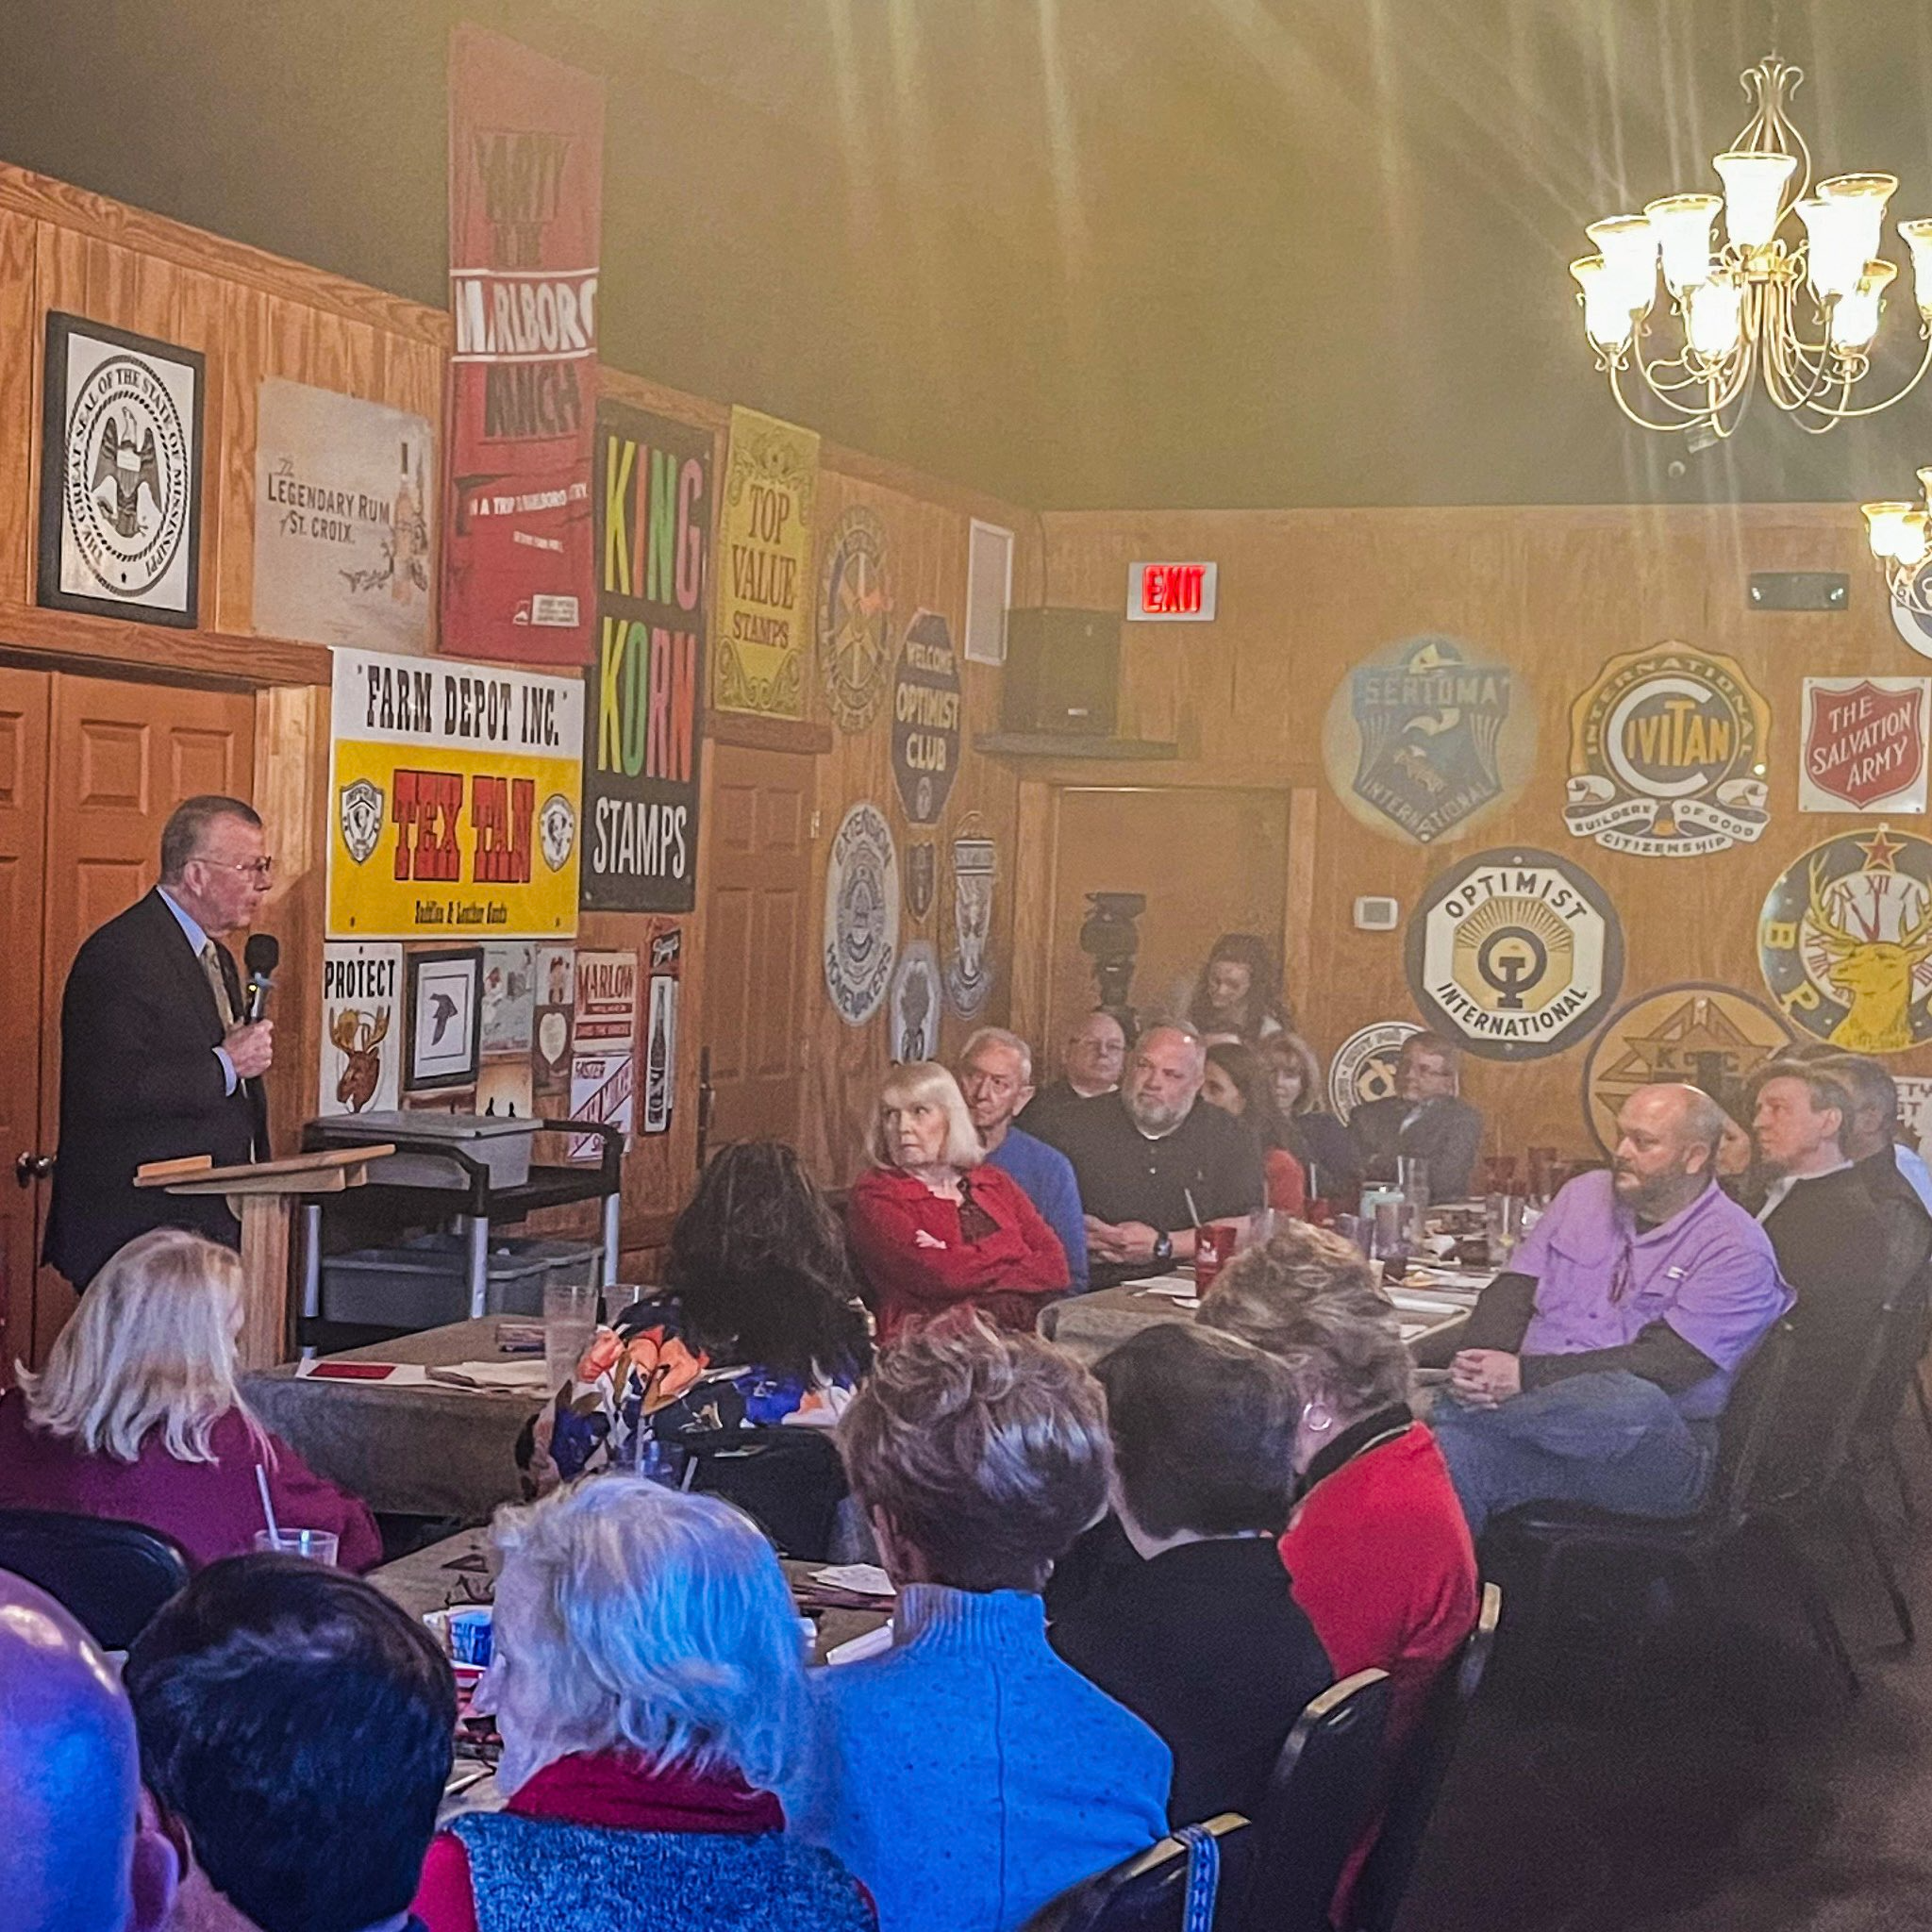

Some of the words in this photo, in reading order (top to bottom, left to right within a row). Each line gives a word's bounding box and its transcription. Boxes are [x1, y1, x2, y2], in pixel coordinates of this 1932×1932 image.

[97, 370, 113, 394] OF
[115, 368, 141, 387] THE
[141, 374, 174, 427] STATE
[76, 391, 99, 439] SEAL
[168, 431, 181, 457] OF
[73, 448, 88, 524] GREAT
[268, 473, 355, 517] LEGENDARY
[358, 493, 391, 525] RUM
[605, 435, 704, 611] KING
[748, 483, 791, 544] TOP
[731, 543, 797, 610] VALUE
[1141, 565, 1207, 613] EXIT
[732, 609, 791, 650] STAMPS
[366, 664, 433, 734] FARM
[443, 675, 512, 742] DEPOT
[521, 685, 560, 747] INC.
[596, 615, 698, 782] KORN
[896, 681, 960, 732] OPTIMIST
[1365, 675, 1500, 707] SERTOMA
[1586, 657, 1754, 759] INTERNATIONAL
[1828, 695, 1874, 735] THE
[906, 732, 946, 772] CLUB
[1811, 702, 1913, 776] SALVATION
[1845, 737, 1909, 793] ARMY
[391, 768, 464, 882] TEX
[1360, 777, 1491, 836] INTERNATIONAL
[1679, 804, 1704, 816] OF
[1707, 814, 1756, 838] GOOD
[592, 795, 688, 879] STAMPS
[1602, 832, 1726, 854] CITIZENSHIP
[1444, 871, 1589, 923] OPTIMIST
[324, 958, 396, 1000] PROTECT
[1436, 982, 1590, 1038] INTERNATIONAL
